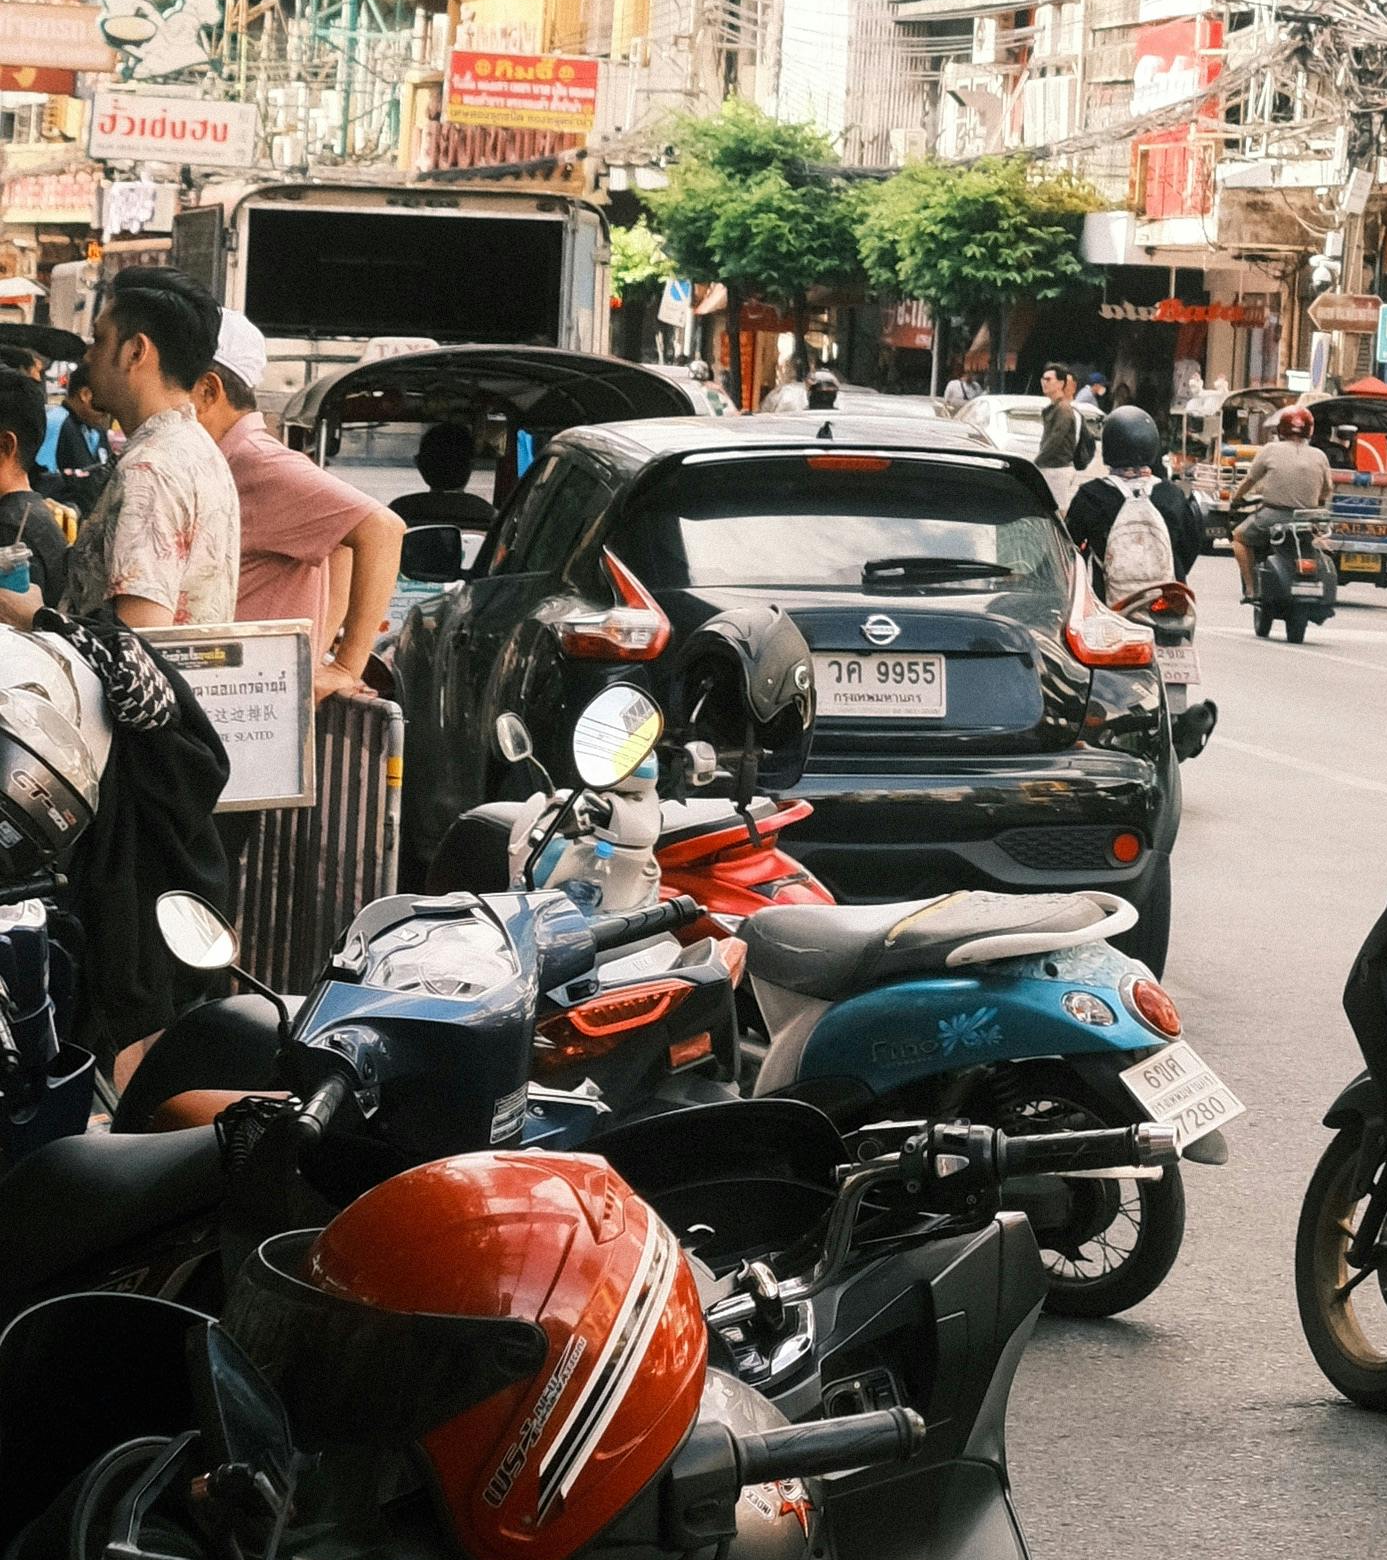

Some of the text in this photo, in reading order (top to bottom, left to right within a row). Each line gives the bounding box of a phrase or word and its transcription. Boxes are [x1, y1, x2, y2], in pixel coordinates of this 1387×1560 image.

[828, 659, 937, 686] วค 9955
[1175, 1094, 1227, 1135] 7280
